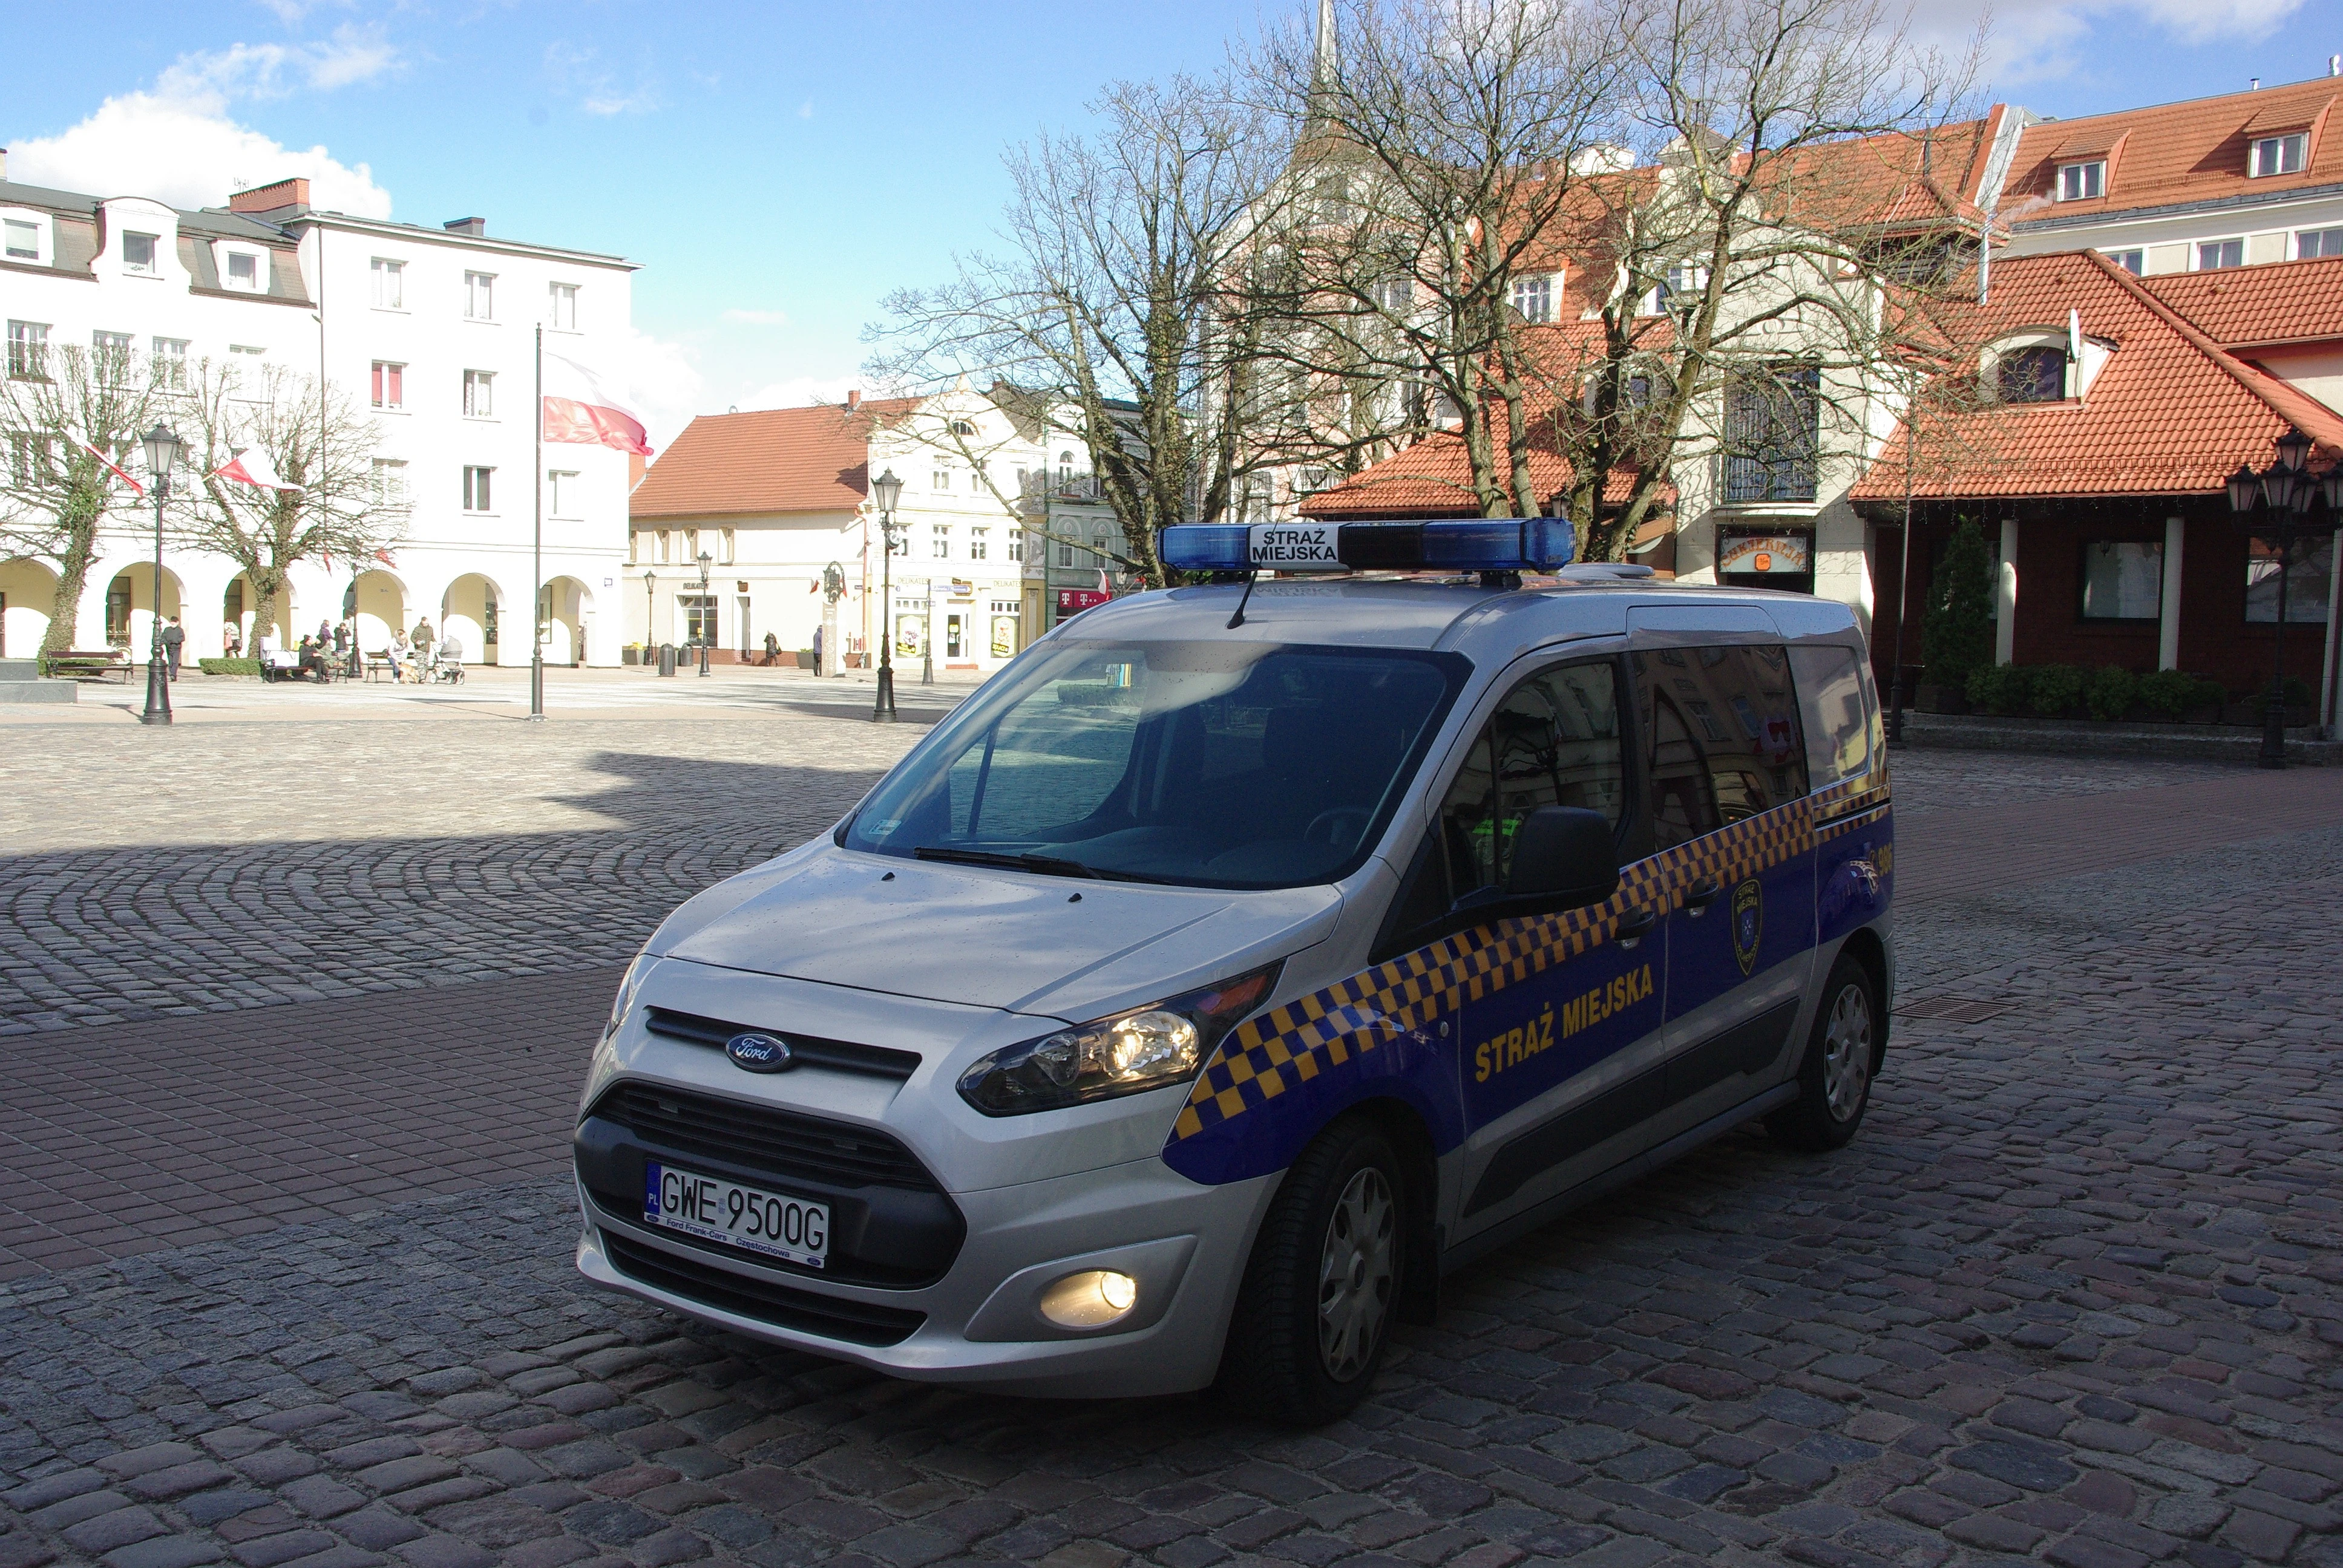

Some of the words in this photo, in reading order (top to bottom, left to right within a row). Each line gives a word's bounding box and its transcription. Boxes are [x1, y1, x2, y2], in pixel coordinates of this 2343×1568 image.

[1263, 528, 1326, 544] STRAŻ
[1252, 546, 1337, 560] MIEJSKA
[1475, 1001, 1554, 1083] STRAŻ
[1562, 963, 1653, 1039] MIEJSKA
[735, 1037, 773, 1060] Ford
[648, 1192, 658, 1206] PL
[662, 1172, 717, 1226] GWE
[727, 1189, 824, 1251] 9500G
[666, 1218, 684, 1230] Ford
[685, 1223, 727, 1241] Frank-Cars
[736, 1238, 790, 1258] Częstochowa
